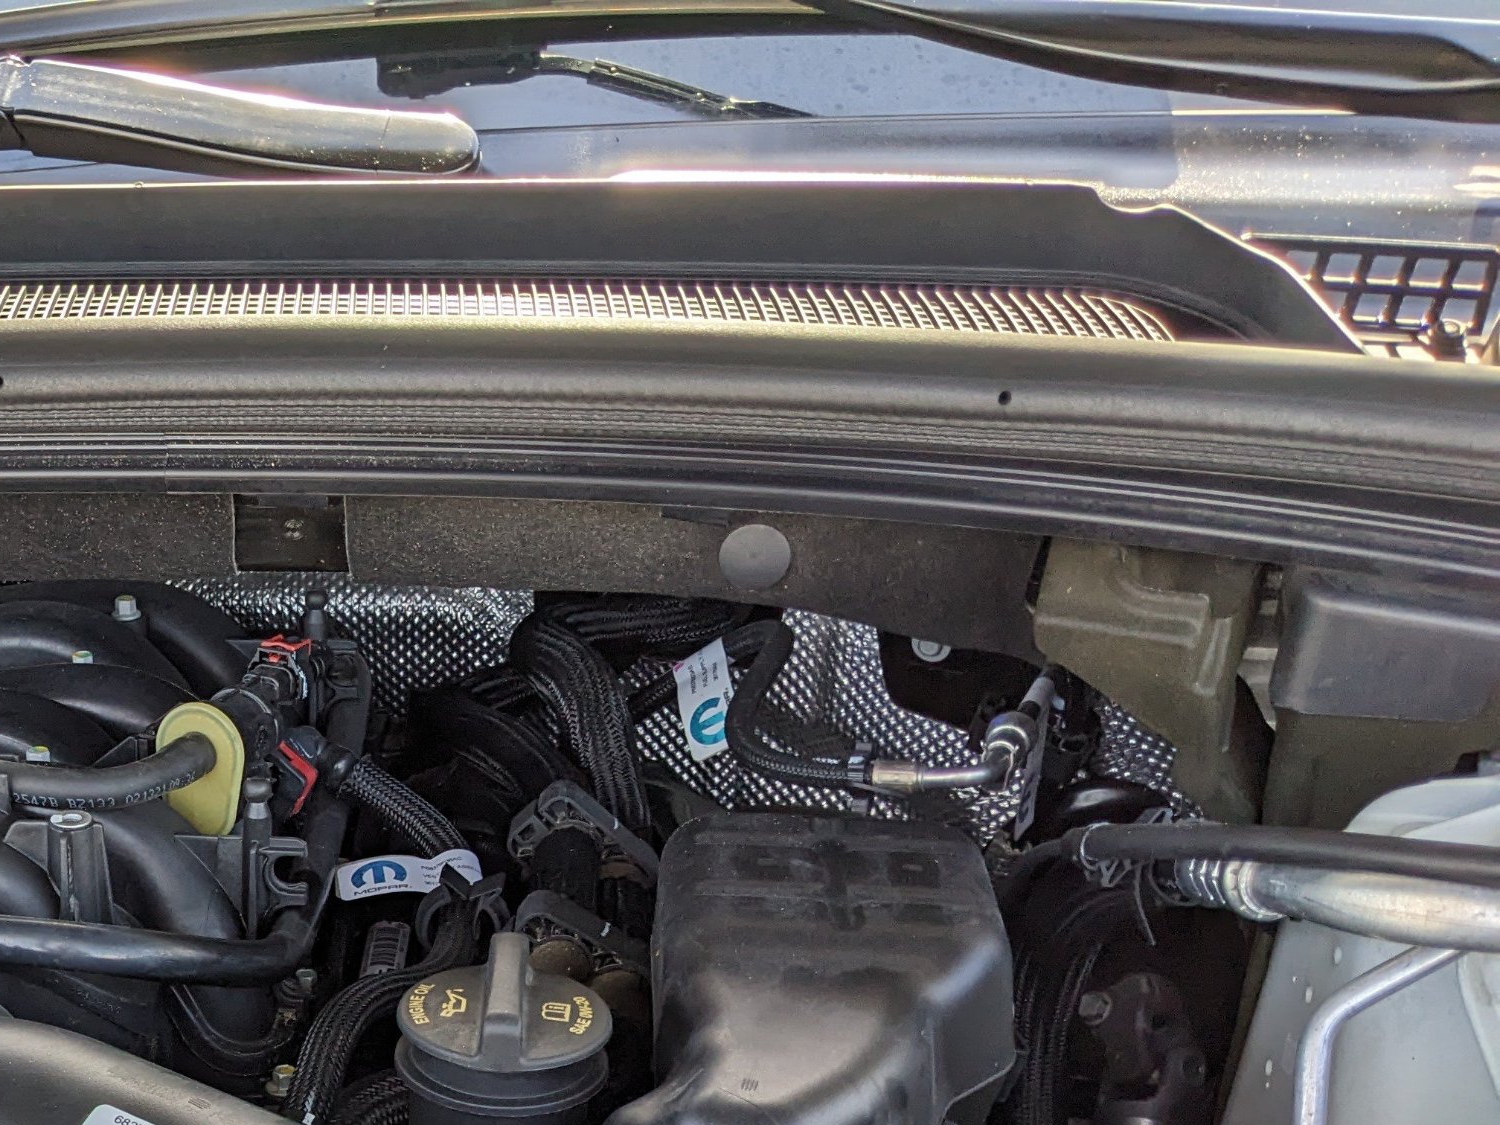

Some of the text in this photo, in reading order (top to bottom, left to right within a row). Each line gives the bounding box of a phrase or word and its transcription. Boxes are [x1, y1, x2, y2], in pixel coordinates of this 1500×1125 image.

[353, 883, 409, 897] MOPAR
[408, 983, 437, 1025] ENGINE OIL
[569, 996, 594, 1035] SAE 0W-20
